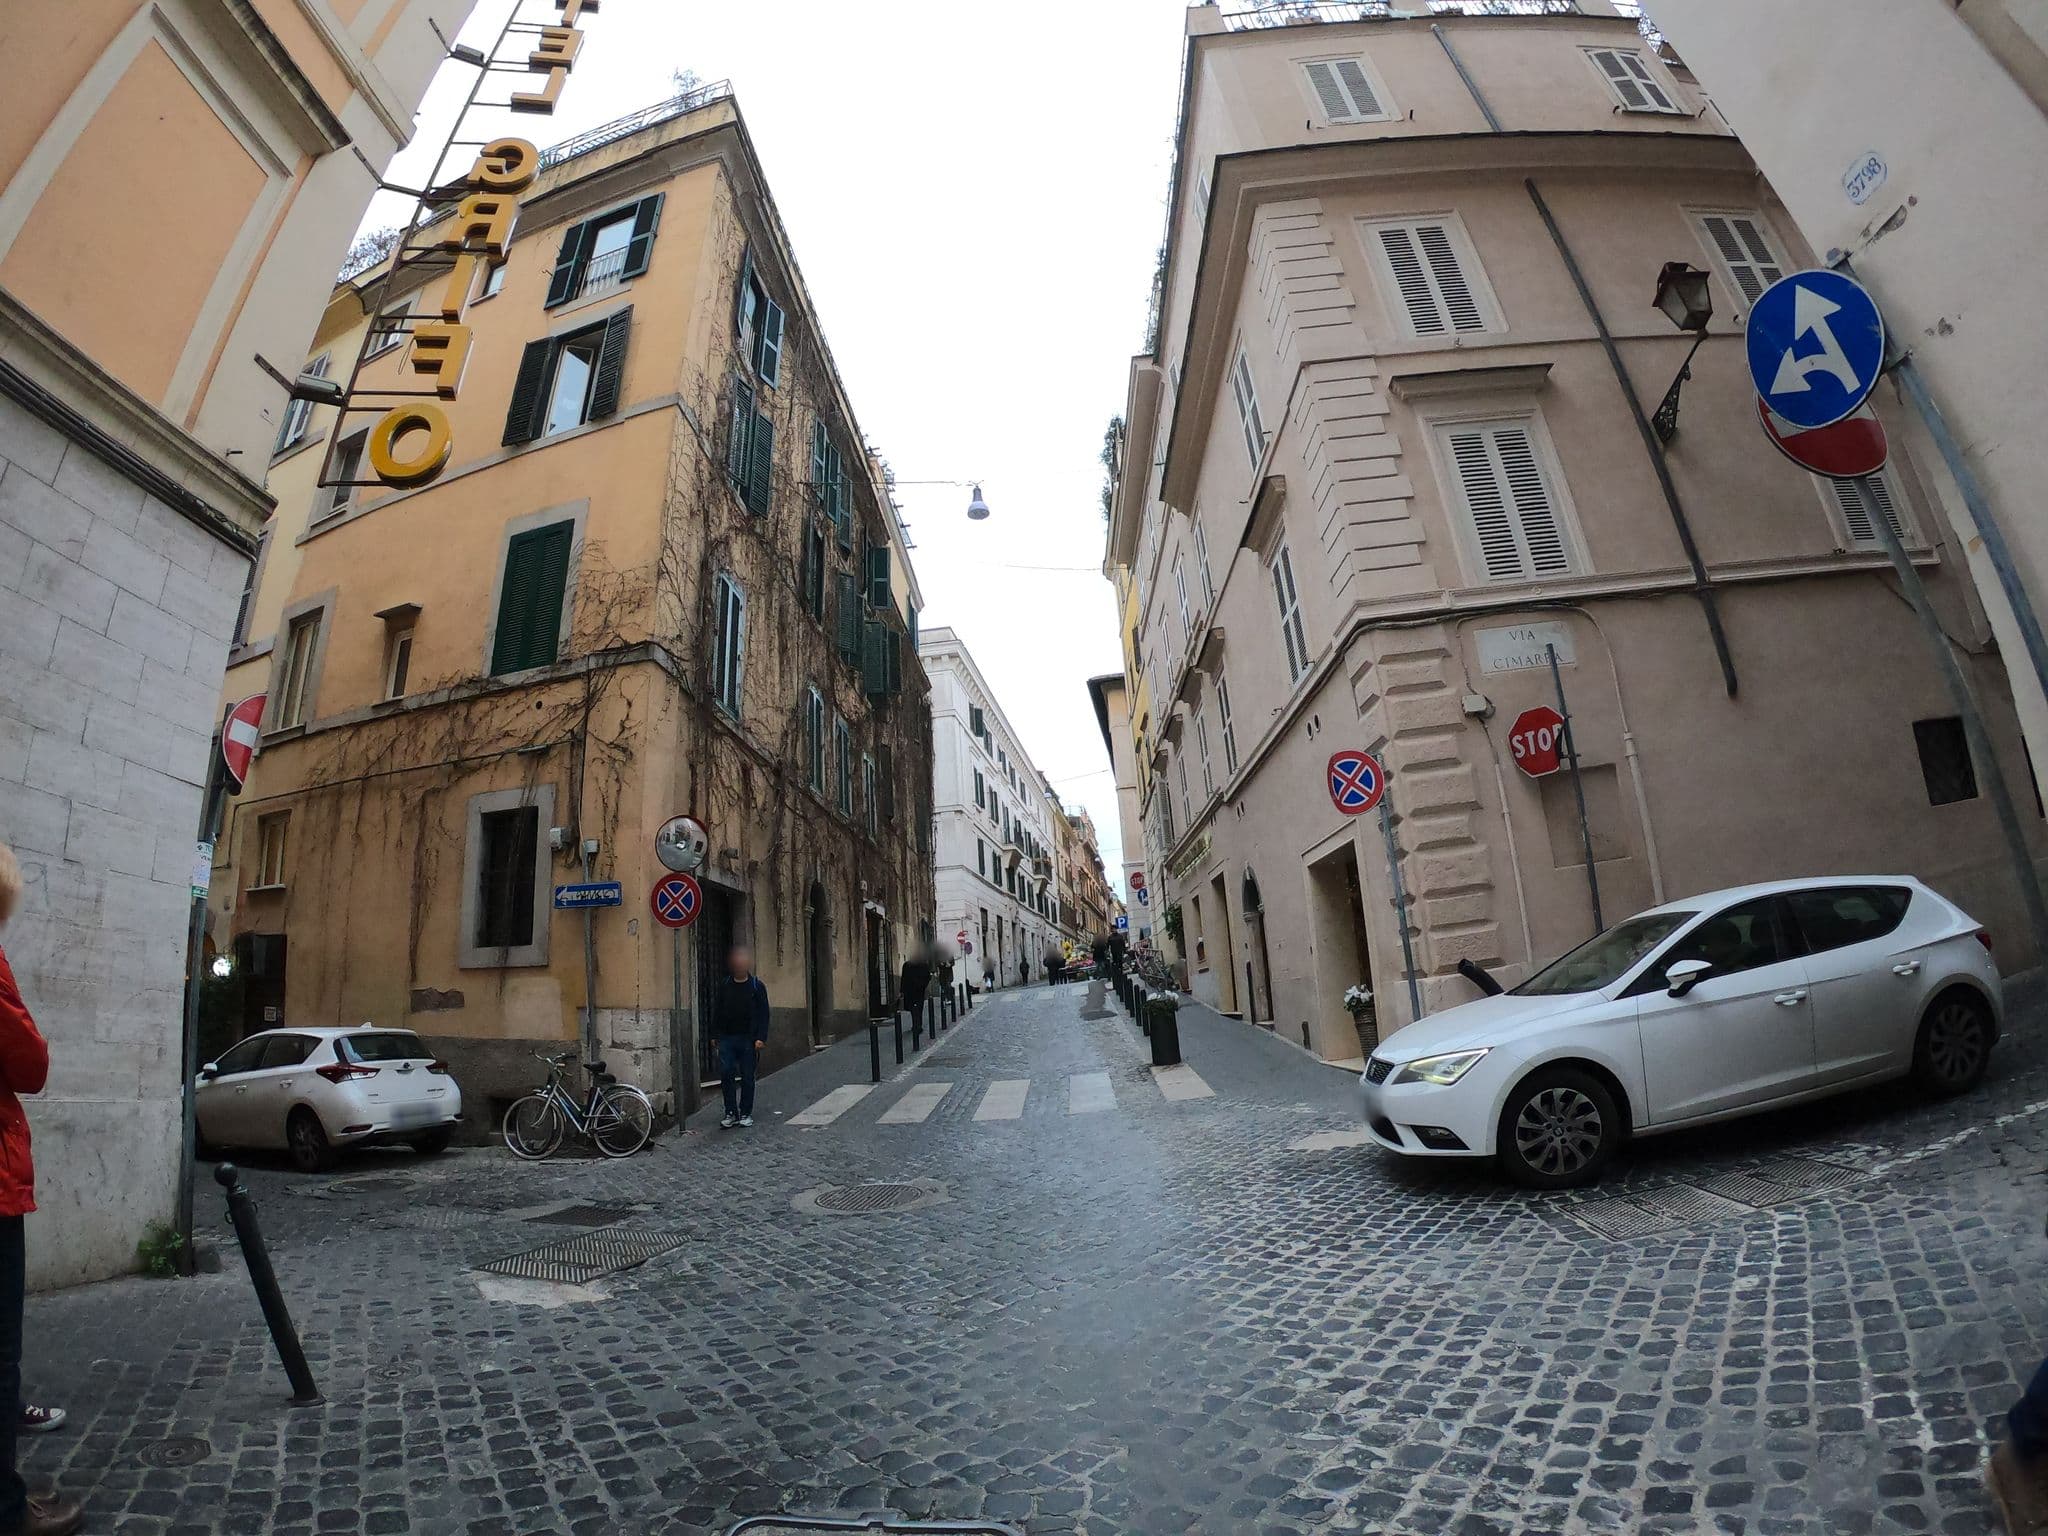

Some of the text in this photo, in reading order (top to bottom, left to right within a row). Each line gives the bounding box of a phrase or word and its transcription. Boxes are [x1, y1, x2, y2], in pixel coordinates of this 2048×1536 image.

[1847, 157, 1881, 198] 5798
[1508, 630, 1536, 641] VIA
[1118, 917, 1125, 928] P
